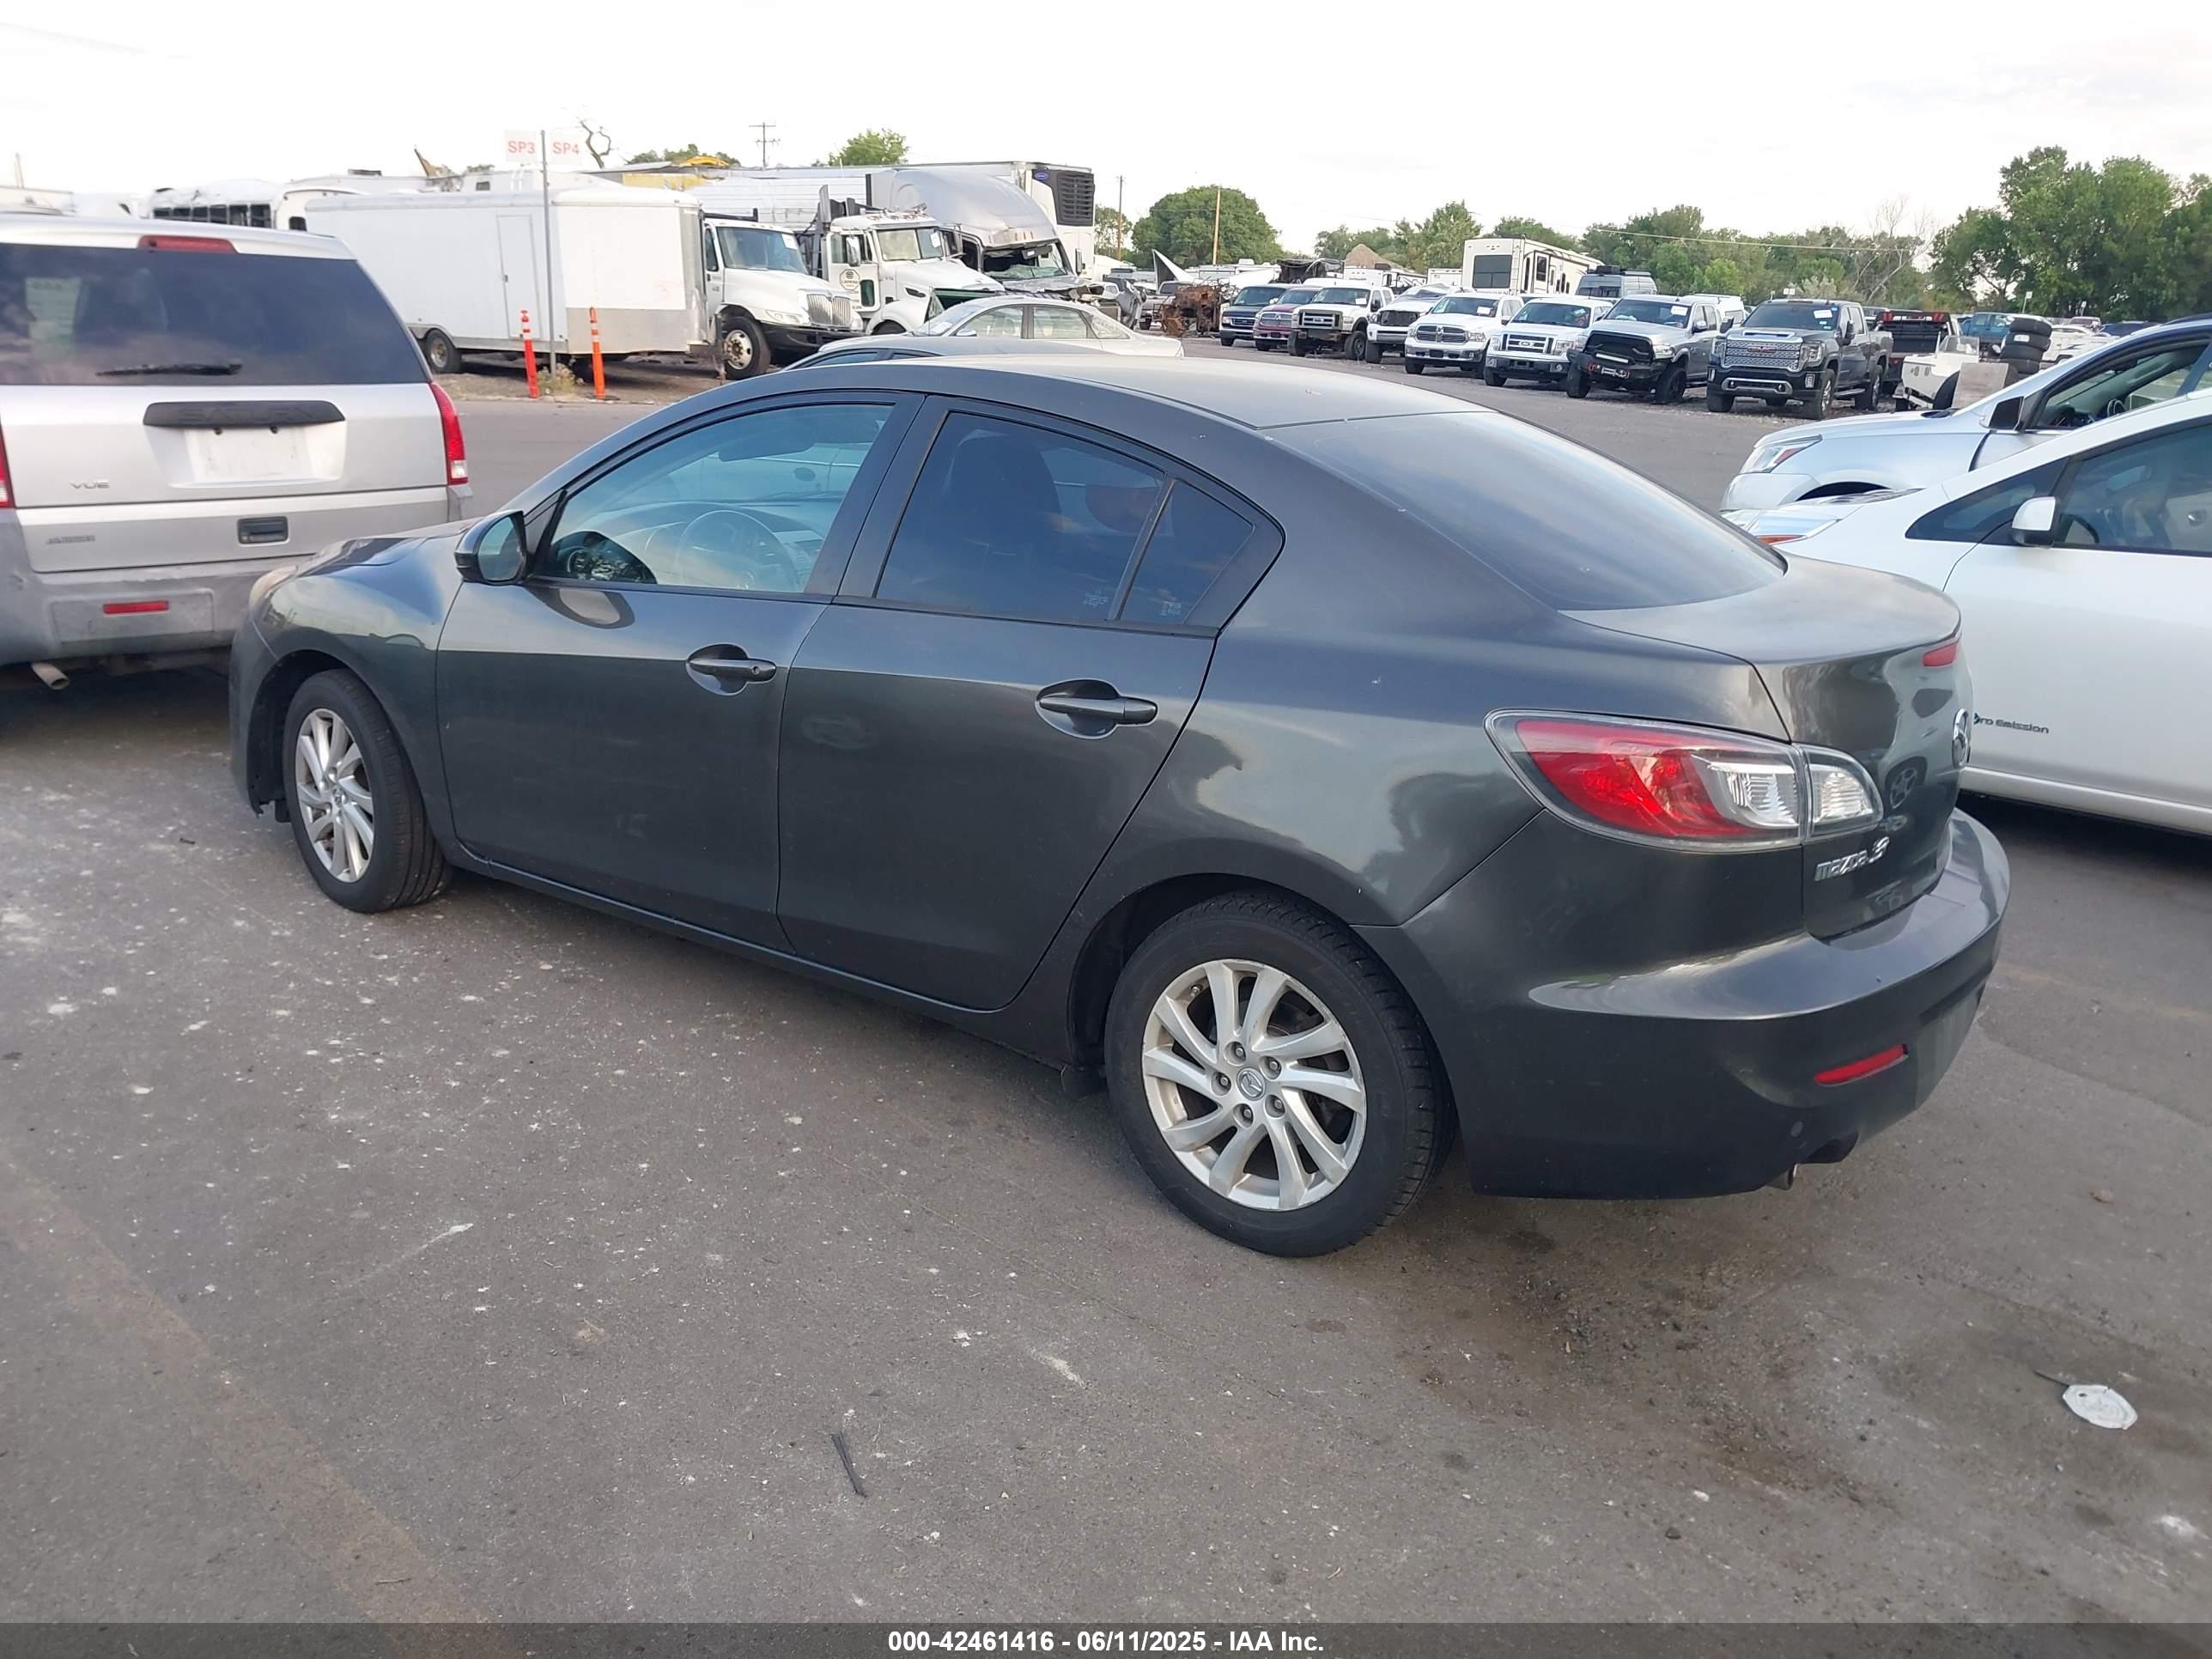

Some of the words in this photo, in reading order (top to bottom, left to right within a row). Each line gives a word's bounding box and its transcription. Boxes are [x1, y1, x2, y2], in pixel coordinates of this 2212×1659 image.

[508, 141, 535, 155] SP3
[553, 142, 580, 155] SP4
[69, 480, 110, 489] VUE
[1996, 720, 2050, 733] Emission
